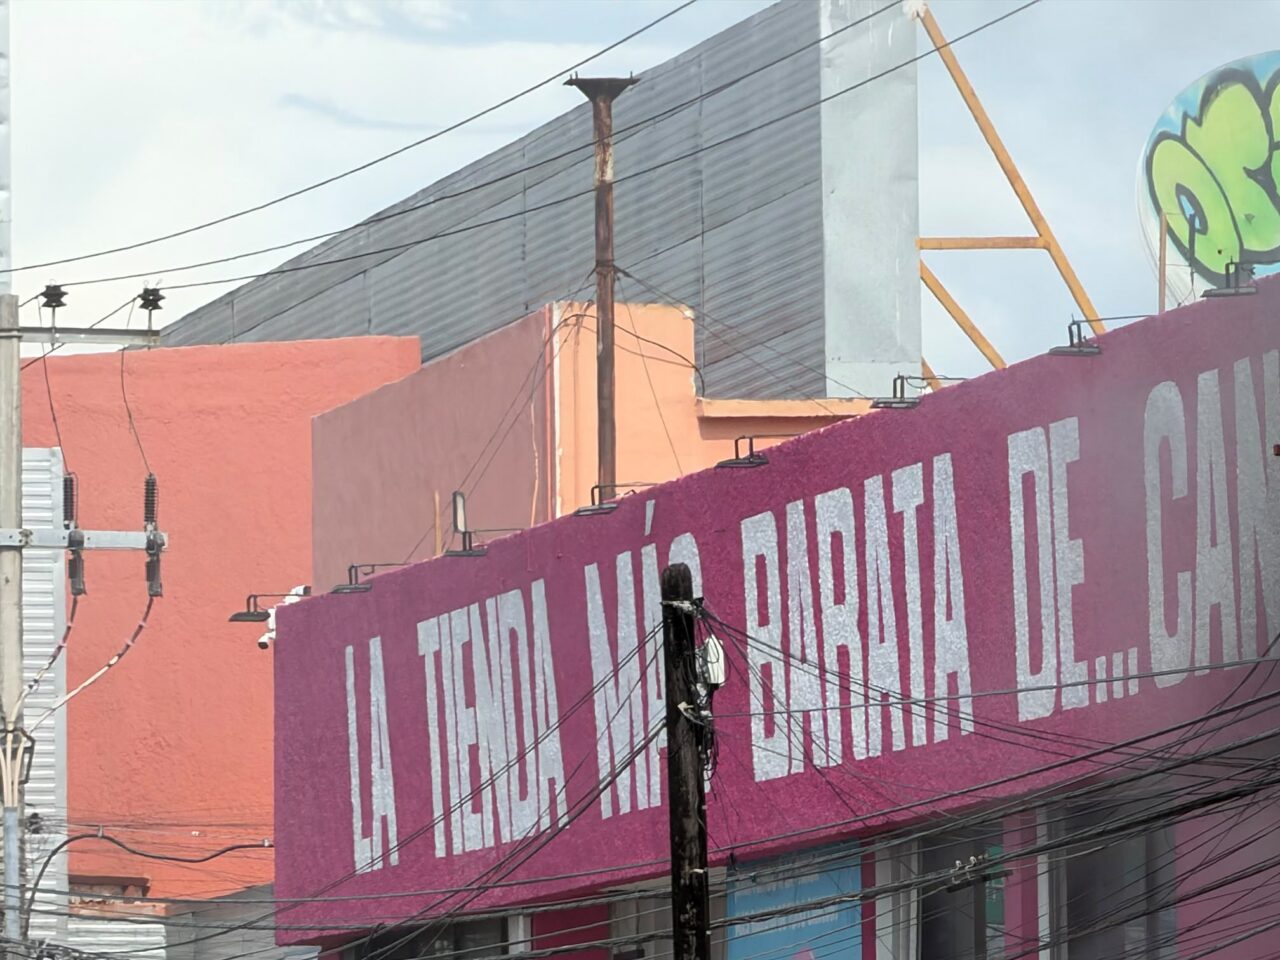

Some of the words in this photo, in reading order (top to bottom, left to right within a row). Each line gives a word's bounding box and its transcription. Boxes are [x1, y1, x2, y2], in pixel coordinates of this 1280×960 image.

[345, 635, 399, 875] LA
[416, 578, 571, 858] TIENDA
[740, 452, 975, 783] BARATA
